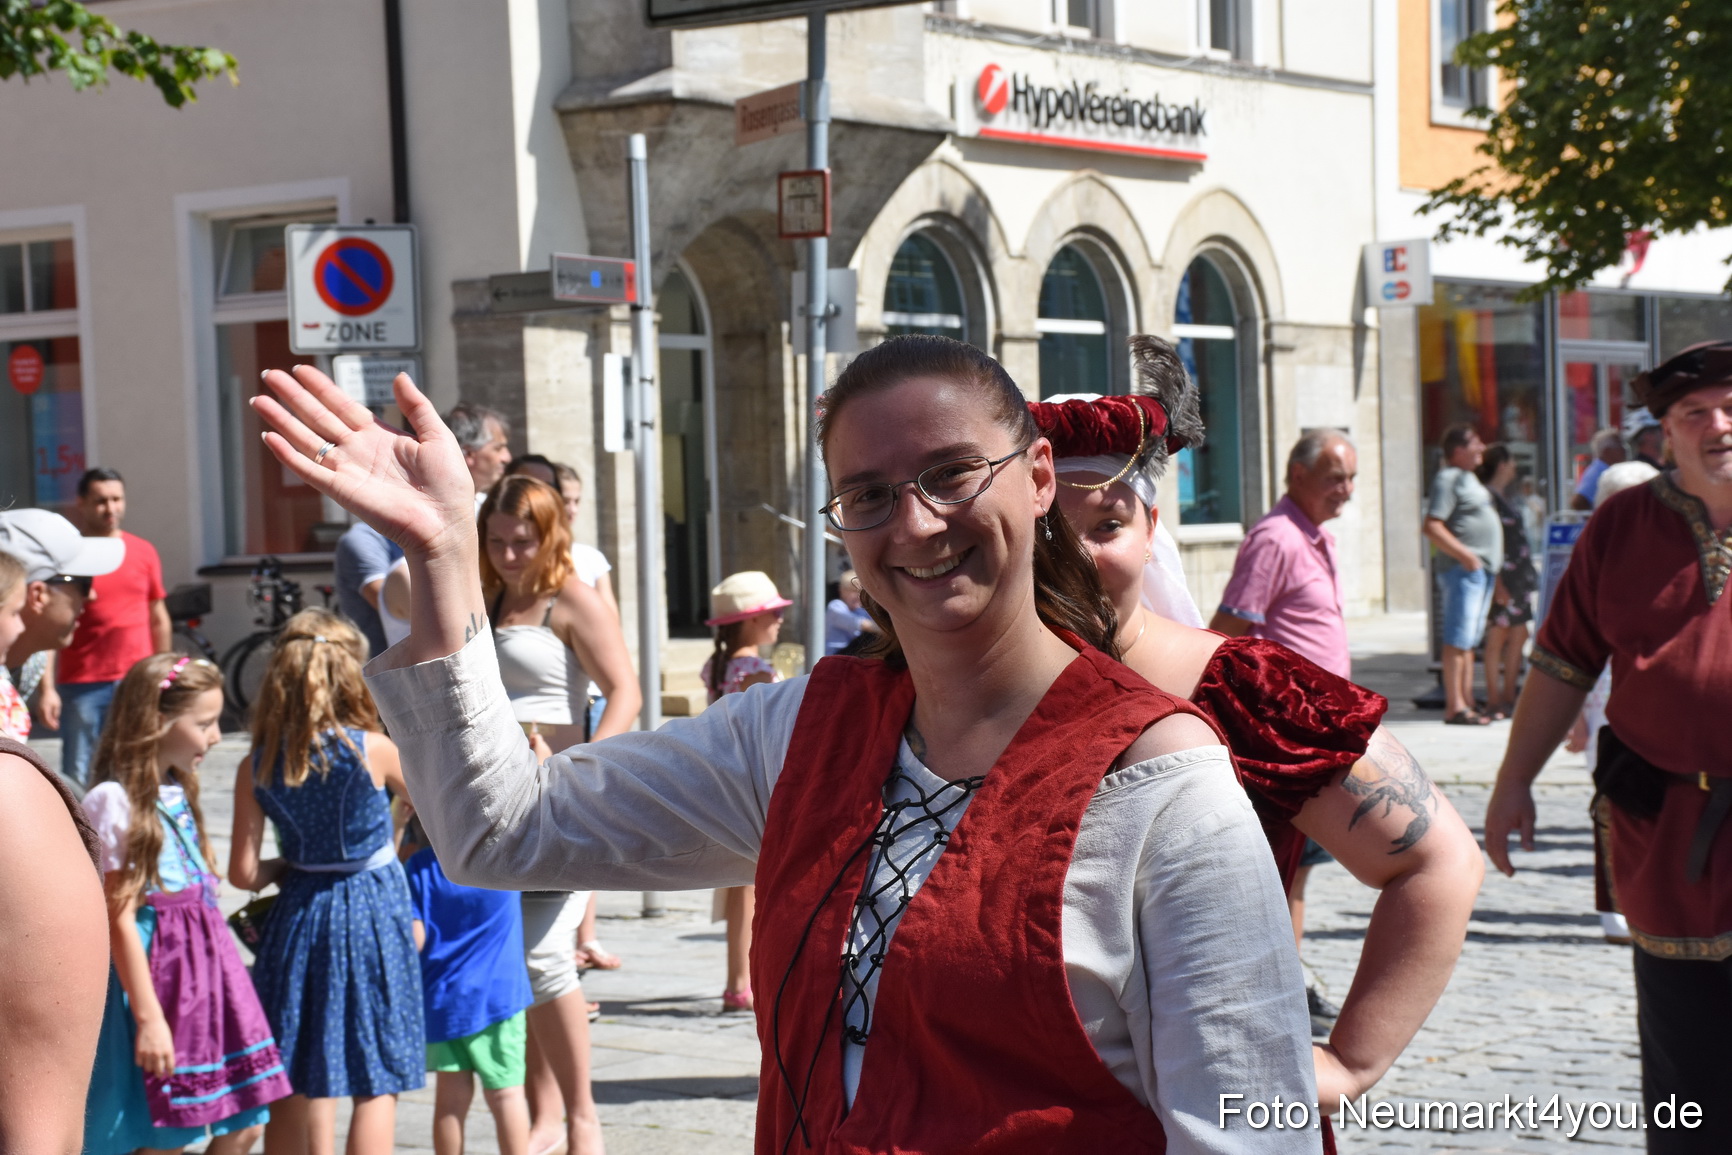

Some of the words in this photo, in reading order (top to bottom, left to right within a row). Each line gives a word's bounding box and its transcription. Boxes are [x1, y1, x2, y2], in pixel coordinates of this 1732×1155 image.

[741, 99, 799, 133] Rosengass
[1012, 72, 1207, 137] HypoVereinsbank
[324, 322, 387, 342] ZONE
